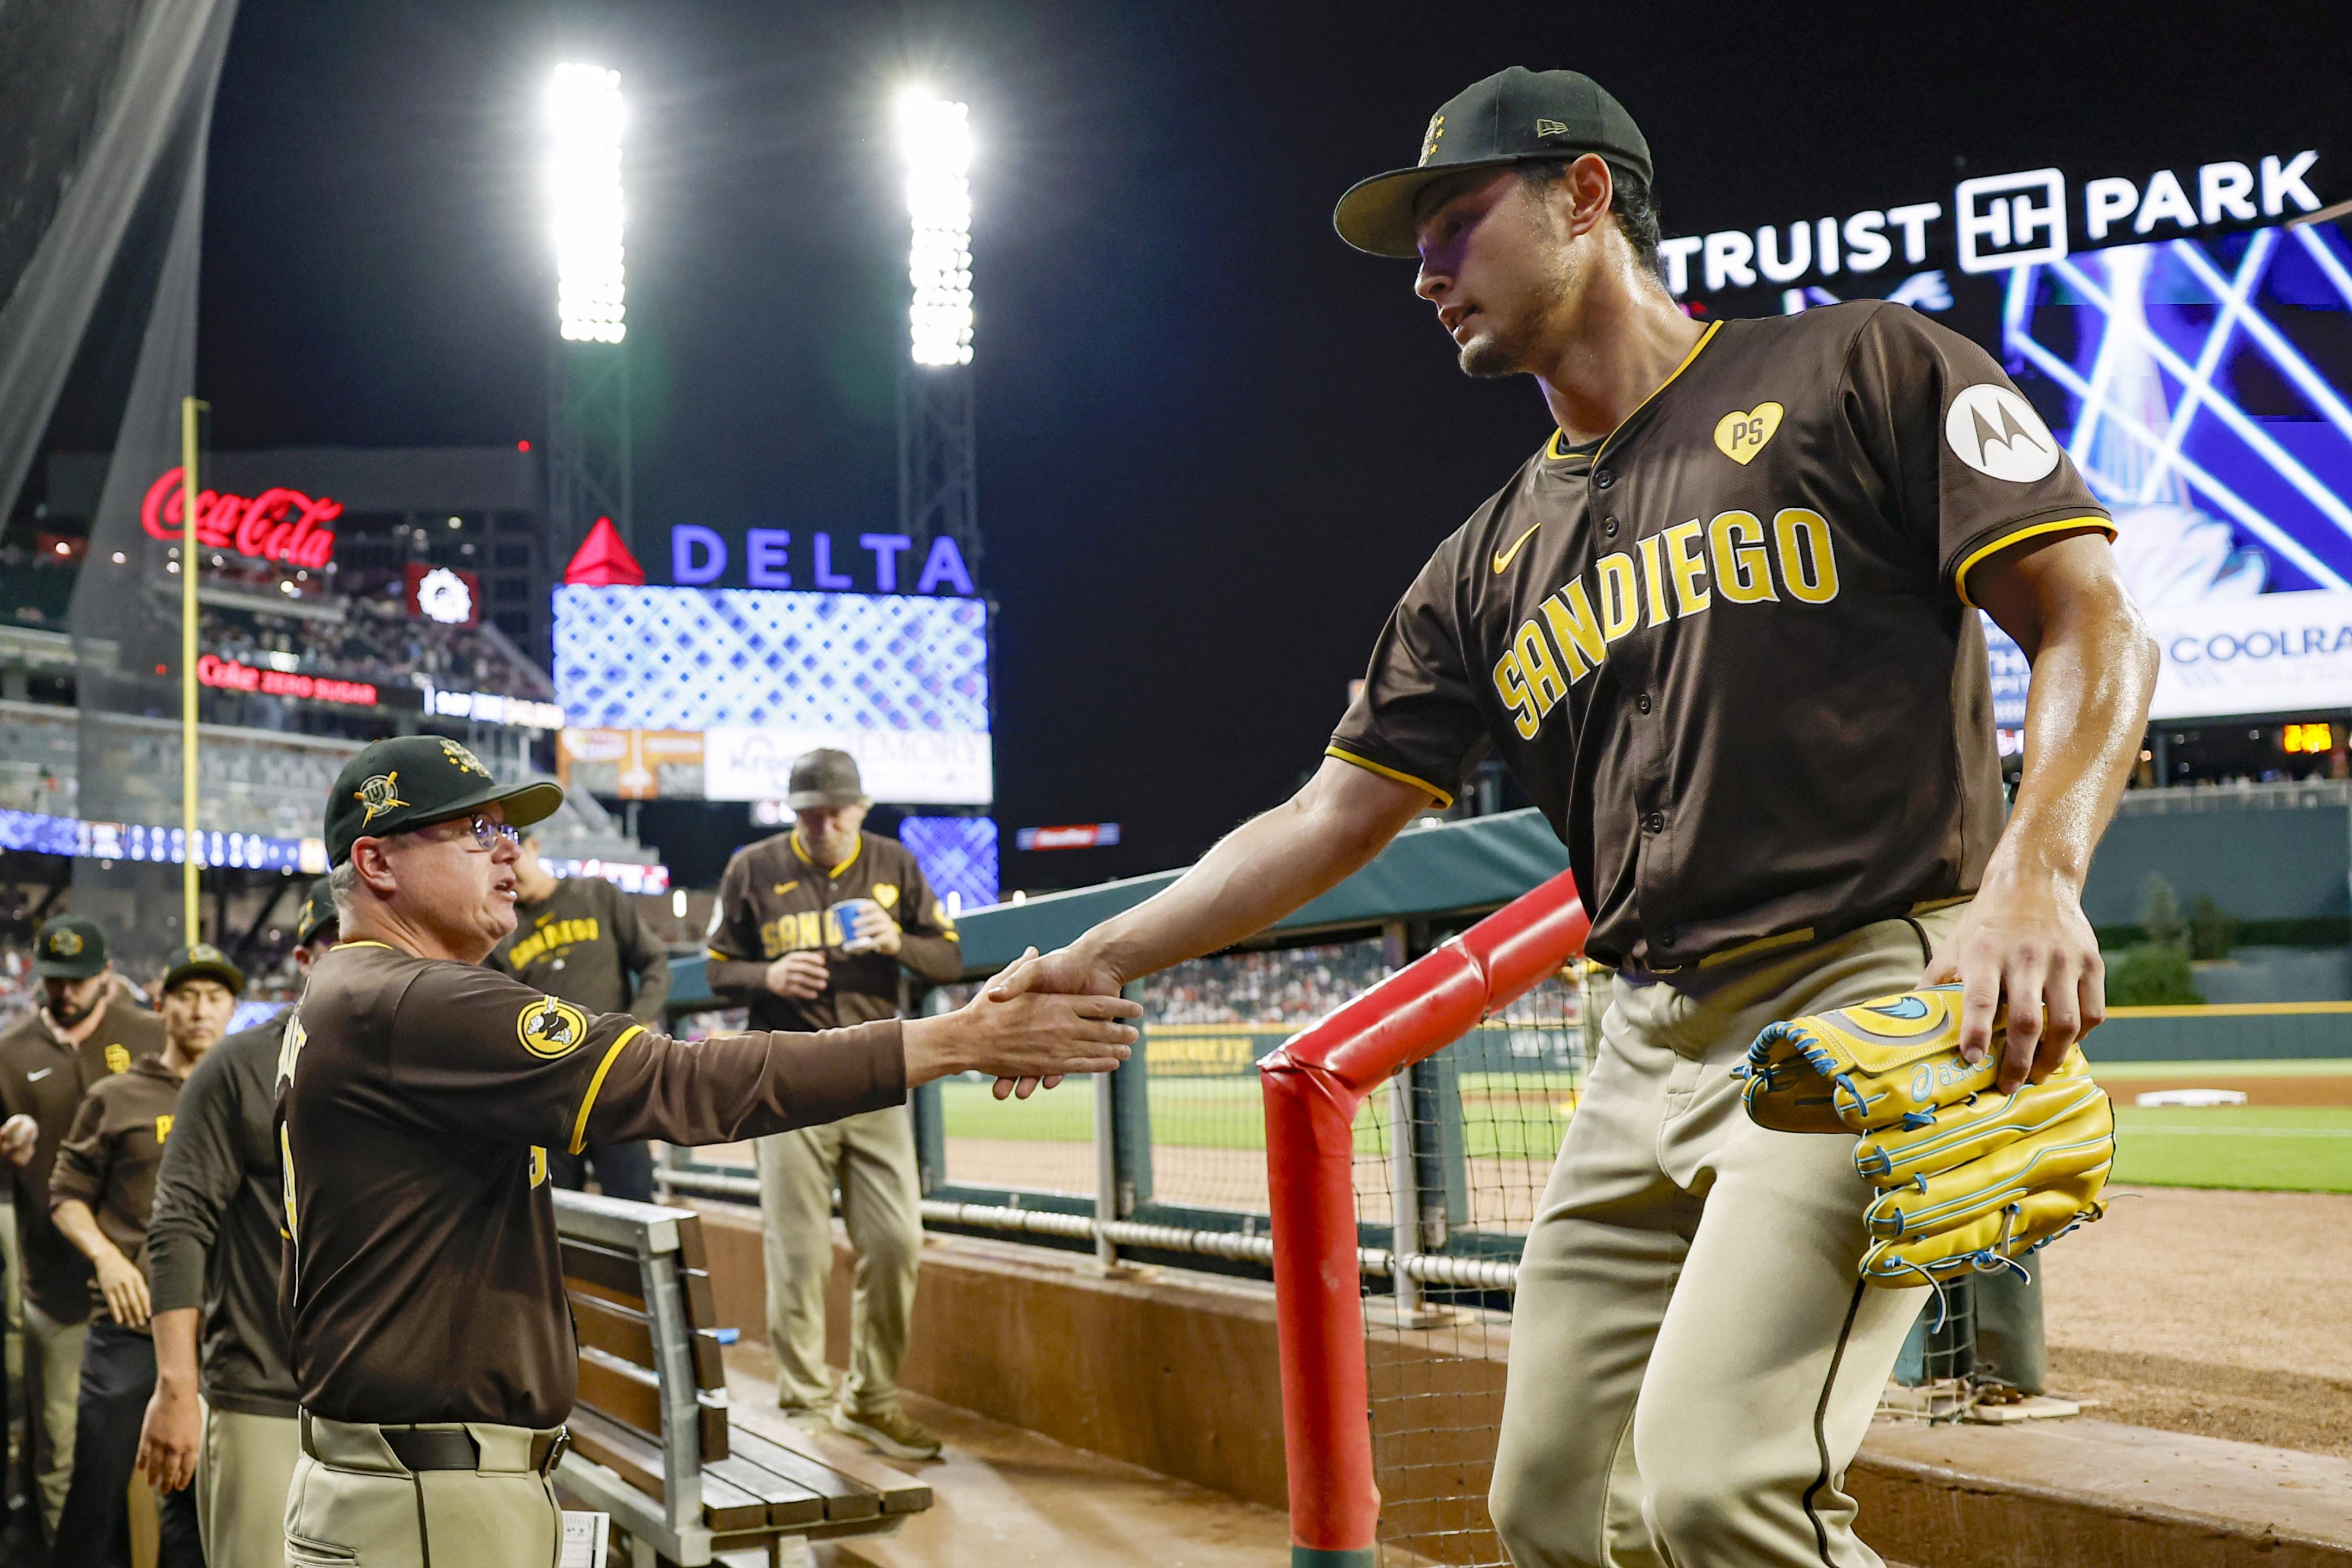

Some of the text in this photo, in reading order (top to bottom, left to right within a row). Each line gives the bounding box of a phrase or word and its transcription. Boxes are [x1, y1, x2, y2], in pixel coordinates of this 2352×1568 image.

[1656, 150, 2322, 296] TRUIST PARK
[1731, 416, 1764, 450] PS
[141, 466, 344, 569] Coca-Cola
[670, 524, 976, 594] DELTA
[1493, 507, 1840, 741] SAN DIEGO
